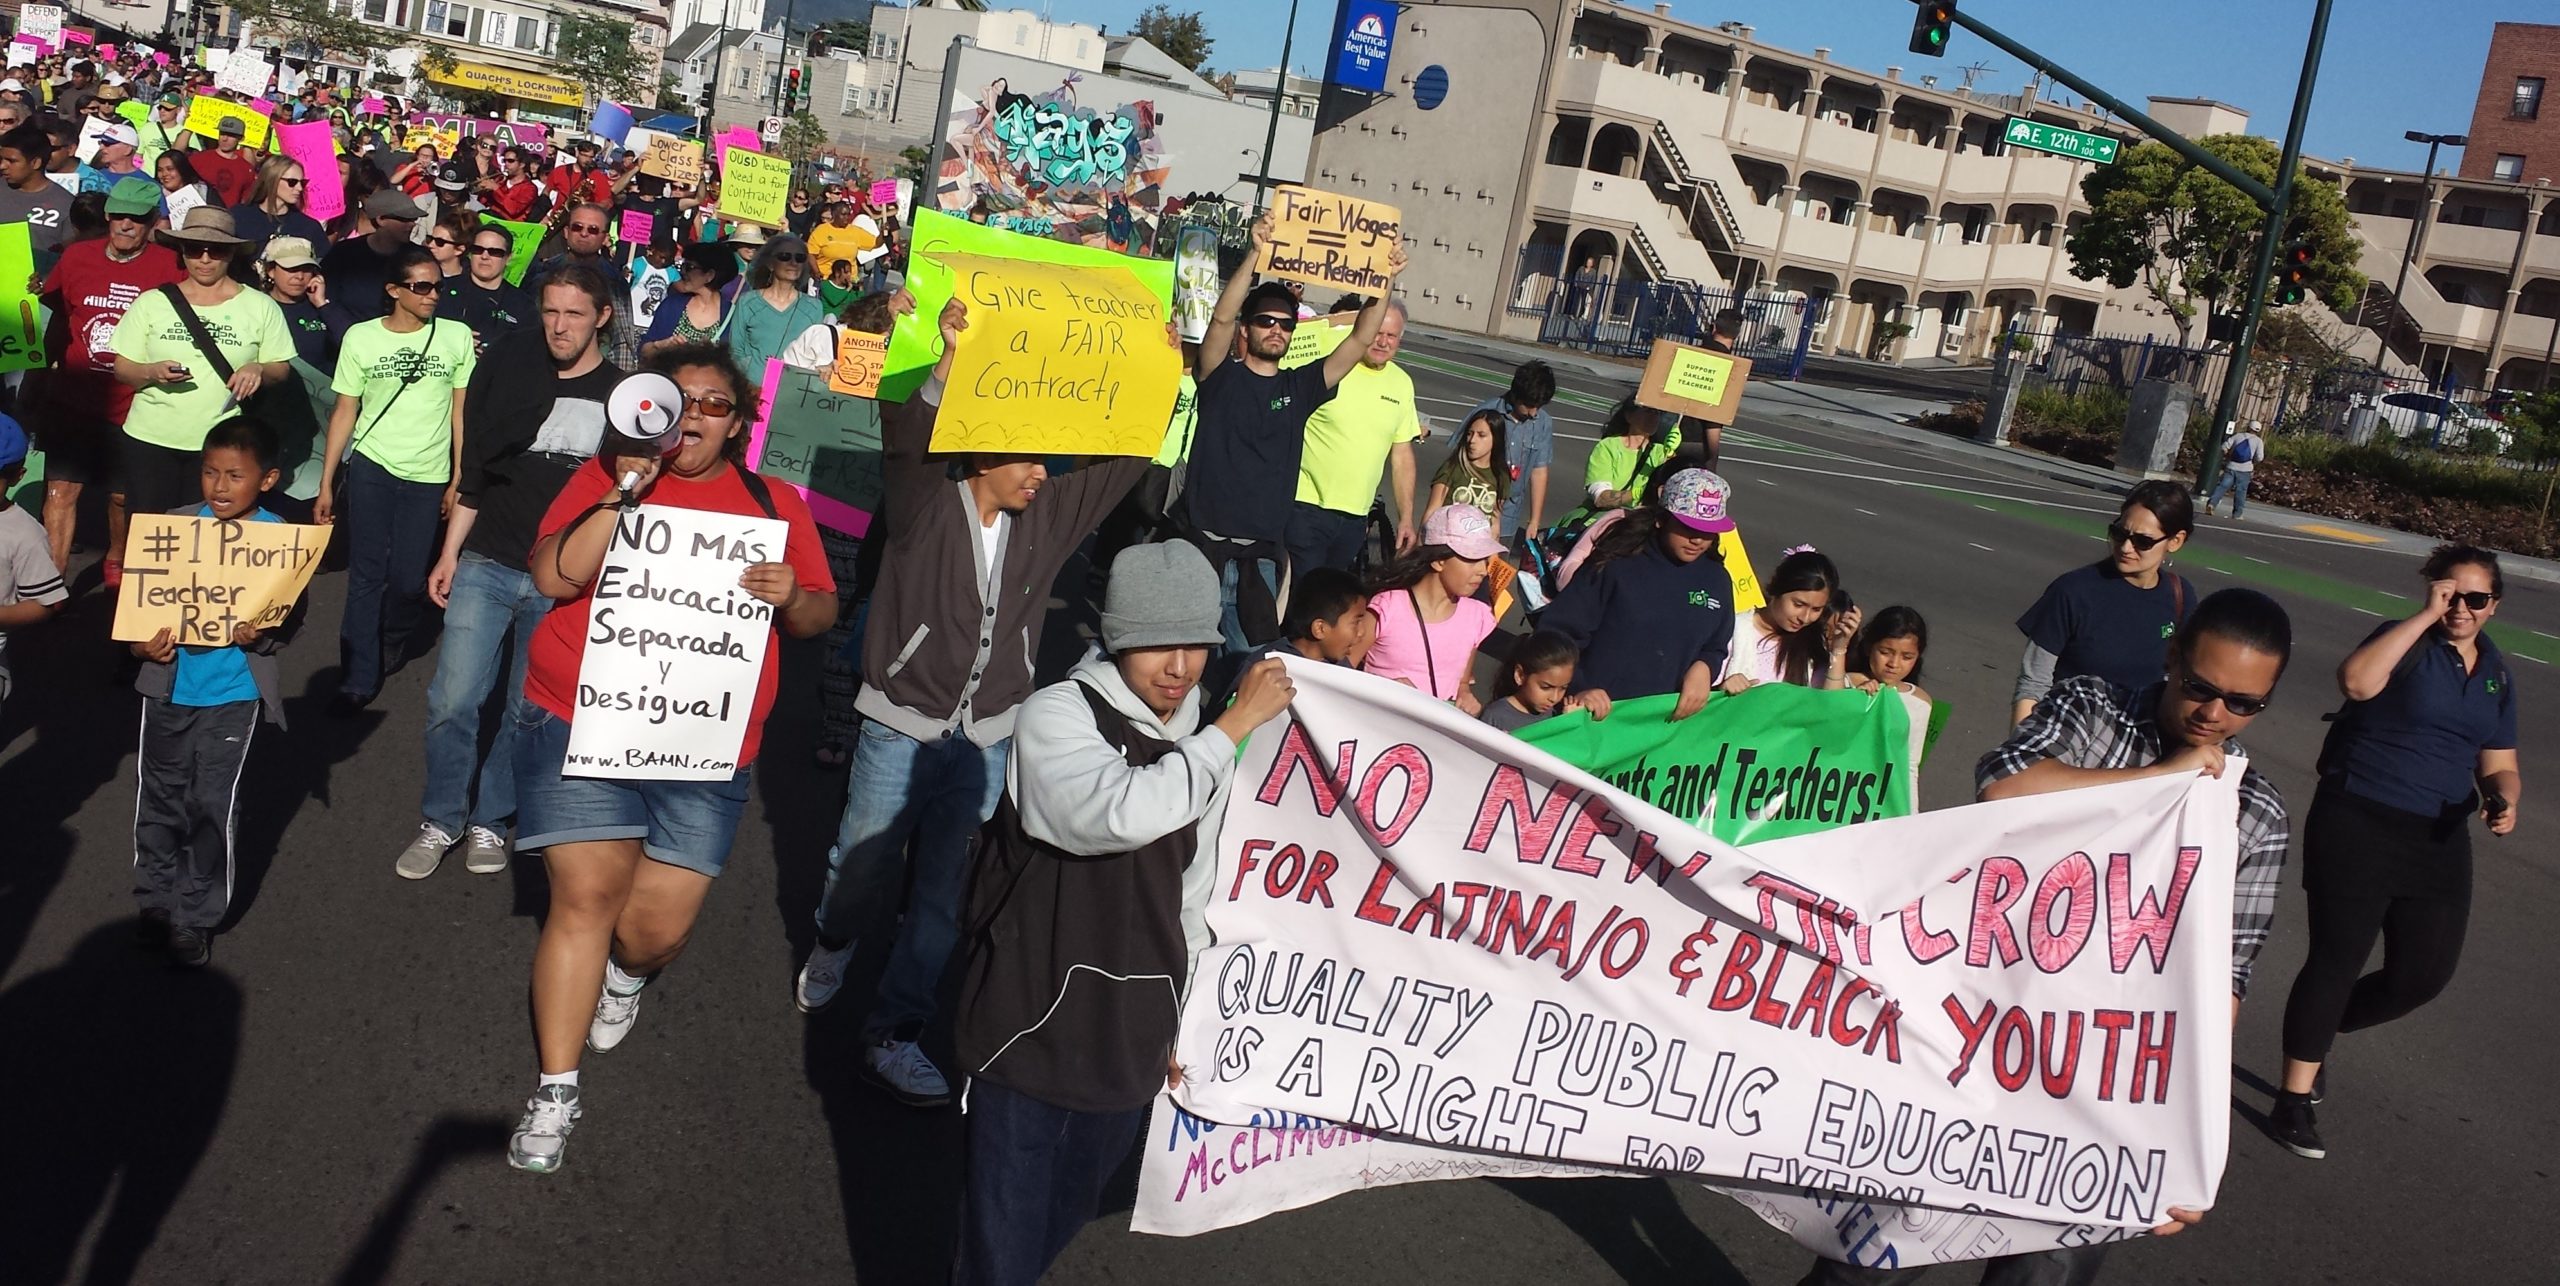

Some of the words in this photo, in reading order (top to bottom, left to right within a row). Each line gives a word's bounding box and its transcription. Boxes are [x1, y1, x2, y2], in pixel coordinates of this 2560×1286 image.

[28, 5, 58, 16] DEFEND
[1347, 29, 1387, 48] Americas
[1344, 40, 1363, 54] Best
[1364, 44, 1386, 60] Value
[1356, 54, 1370, 67] Inn
[465, 70, 512, 85] QUACH'S
[650, 134, 687, 153] Lower
[2031, 127, 2042, 144] E.
[2050, 131, 2079, 152] 12th
[2086, 137, 2095, 147] St
[658, 149, 693, 166] Class
[729, 150, 758, 168] OUSD
[2081, 146, 2095, 157] 100
[660, 164, 699, 182] Sizes
[730, 170, 753, 184] Need
[759, 176, 766, 184] a
[770, 178, 788, 190] fair
[727, 185, 778, 205] Contract
[738, 201, 767, 218] Now!
[1279, 189, 1332, 224] Fair
[1338, 200, 1398, 247] Wages
[83, 295, 132, 311] Hillcre
[971, 271, 1046, 312] Give
[1060, 281, 1157, 320] teacher
[844, 337, 885, 350] ANOTHE
[1010, 330, 1029, 353] a
[1059, 319, 1127, 357] FAIR
[1289, 342, 1317, 351] AKLAND
[374, 363, 446, 372] EDUCATION
[379, 355, 440, 363] OAKLAND
[371, 370, 451, 380] ASSOCATION
[1683, 371, 1714, 383] OAKLAND
[1686, 363, 1717, 375] SUPPORT
[796, 371, 850, 413] Fair
[1677, 378, 1714, 392] TEACHERS!
[610, 513, 672, 555] NO
[690, 529, 767, 565] MÁS
[212, 519, 319, 580] Priority
[123, 567, 246, 608] Teacher
[595, 565, 770, 622] Educación
[590, 607, 752, 663] Separada
[579, 684, 731, 724] Desigual
[1660, 742, 1729, 819] and
[1730, 747, 1893, 824] Teachers!
[1256, 718, 1432, 848] NO
[1463, 762, 1711, 890] NEW
[1900, 846, 2203, 975] CROW
[1229, 839, 1339, 908] FOR
[1354, 857, 1650, 982] LATINA/O
[1708, 930, 1903, 1064] BLACK
[1941, 992, 2178, 1104] YOUTH
[1209, 1025, 1264, 1083] IS
[1276, 1037, 1324, 1098] A
[1346, 1046, 1588, 1158] RIGHT
[1217, 944, 1493, 1059] QUALITY
[1513, 999, 1780, 1137] PUBLIC
[1805, 1078, 2167, 1224] EDUCATION
